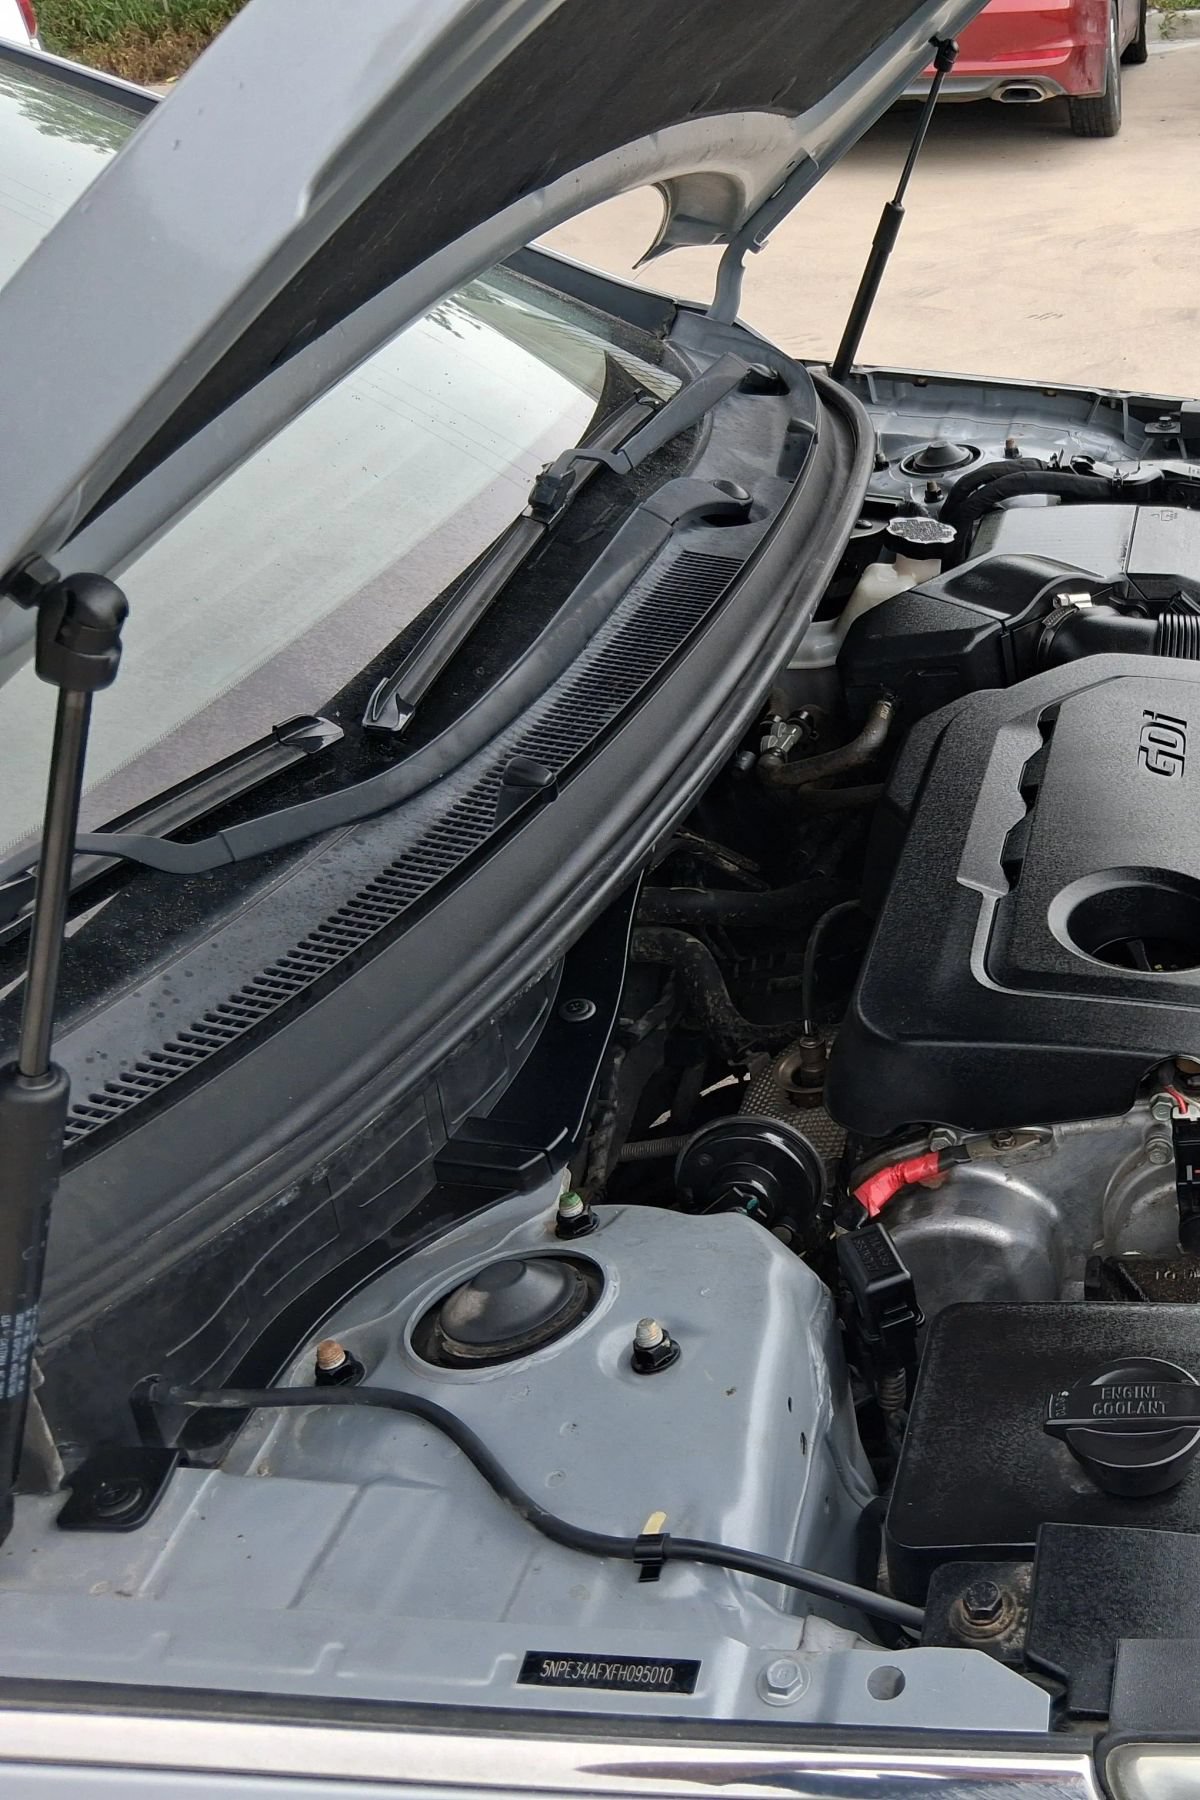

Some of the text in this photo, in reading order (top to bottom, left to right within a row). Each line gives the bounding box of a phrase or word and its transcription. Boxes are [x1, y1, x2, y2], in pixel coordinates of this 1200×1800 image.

[1101, 1386, 1158, 1400] ENGINE
[1092, 1400, 1168, 1416] COOLANT
[539, 1659, 674, 1685] 5NPE34AFXFH095010
